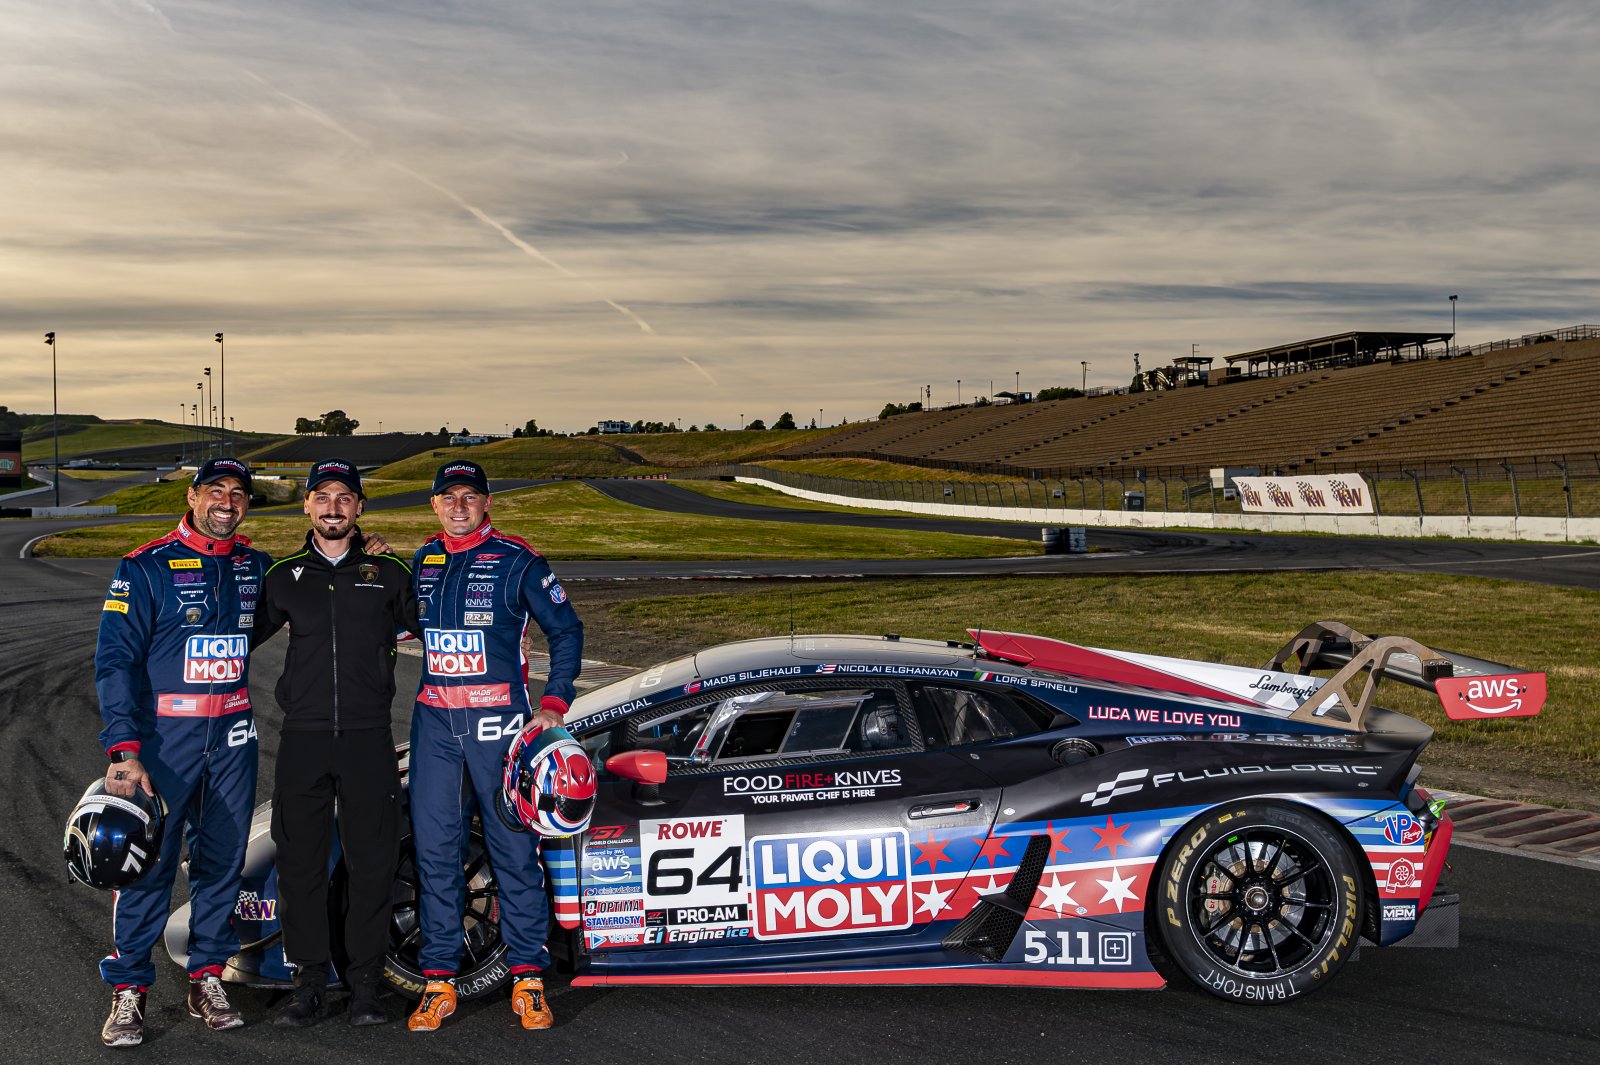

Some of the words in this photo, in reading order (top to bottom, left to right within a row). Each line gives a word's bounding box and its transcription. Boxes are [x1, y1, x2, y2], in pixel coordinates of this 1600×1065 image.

[318, 462, 349, 471] CHICAGO
[444, 464, 476, 474] CHICAGO
[1244, 490, 1262, 507] KW
[1272, 490, 1294, 507] KW
[1303, 489, 1326, 507] KW
[1337, 487, 1363, 507] KW
[111, 579, 130, 592] aws
[466, 584, 495, 593] FOOD
[465, 598, 493, 606] KNIVES
[191, 638, 244, 658] LIQUI
[426, 632, 480, 654] LIQUI
[190, 659, 244, 680] MOLY
[428, 653, 483, 674] MOLY
[838, 665, 883, 673] NICOLAI
[885, 666, 959, 678] ELGHANAYAN
[703, 674, 737, 688] MADS
[739, 665, 801, 681] SILJEHAUG
[995, 675, 1028, 686] LORIS
[1030, 679, 1078, 694] SPINELLI
[1249, 674, 1319, 699] Lamborghi
[469, 689, 492, 697] MADS
[469, 694, 508, 703] SILJEHAUG
[1467, 678, 1519, 699] aws
[565, 697, 652, 735] CPT.OFFICIAL
[1088, 706, 1131, 721] LUCA
[1134, 708, 1160, 722] WE
[1162, 710, 1204, 725] LOVE
[1207, 713, 1241, 727] YOU
[227, 719, 258, 748] 64
[477, 713, 524, 742] 64
[723, 775, 783, 792] FOOD
[1152, 764, 1378, 787] FLUIDLOGIC
[751, 794, 779, 804] YOUR
[781, 792, 814, 802] PRIVATE
[816, 790, 840, 800] CHEF
[842, 790, 850, 798] IS
[852, 788, 875, 797] HERE
[657, 820, 723, 840] ROWE
[1385, 813, 1413, 845] VP
[1403, 830, 1422, 841] Racing
[591, 855, 631, 872] aws
[761, 837, 899, 884] LIQUI
[1167, 825, 1208, 903] ZERO
[646, 846, 743, 896] 64
[240, 899, 276, 921] KW
[600, 901, 640, 914] OPTIMA
[677, 906, 739, 923] PRO-AM
[764, 884, 905, 931] MOLY
[1167, 907, 1181, 927] P
[1383, 909, 1416, 918] MPM
[586, 917, 606, 927] STAY
[607, 915, 640, 925] FROSTY
[1321, 875, 1357, 974] PIRELLI
[644, 926, 666, 945] Ei
[1024, 930, 1095, 964] 5.11
[455, 961, 511, 999] TRANSPOR
[1198, 969, 1301, 1001] TRANSPORT
